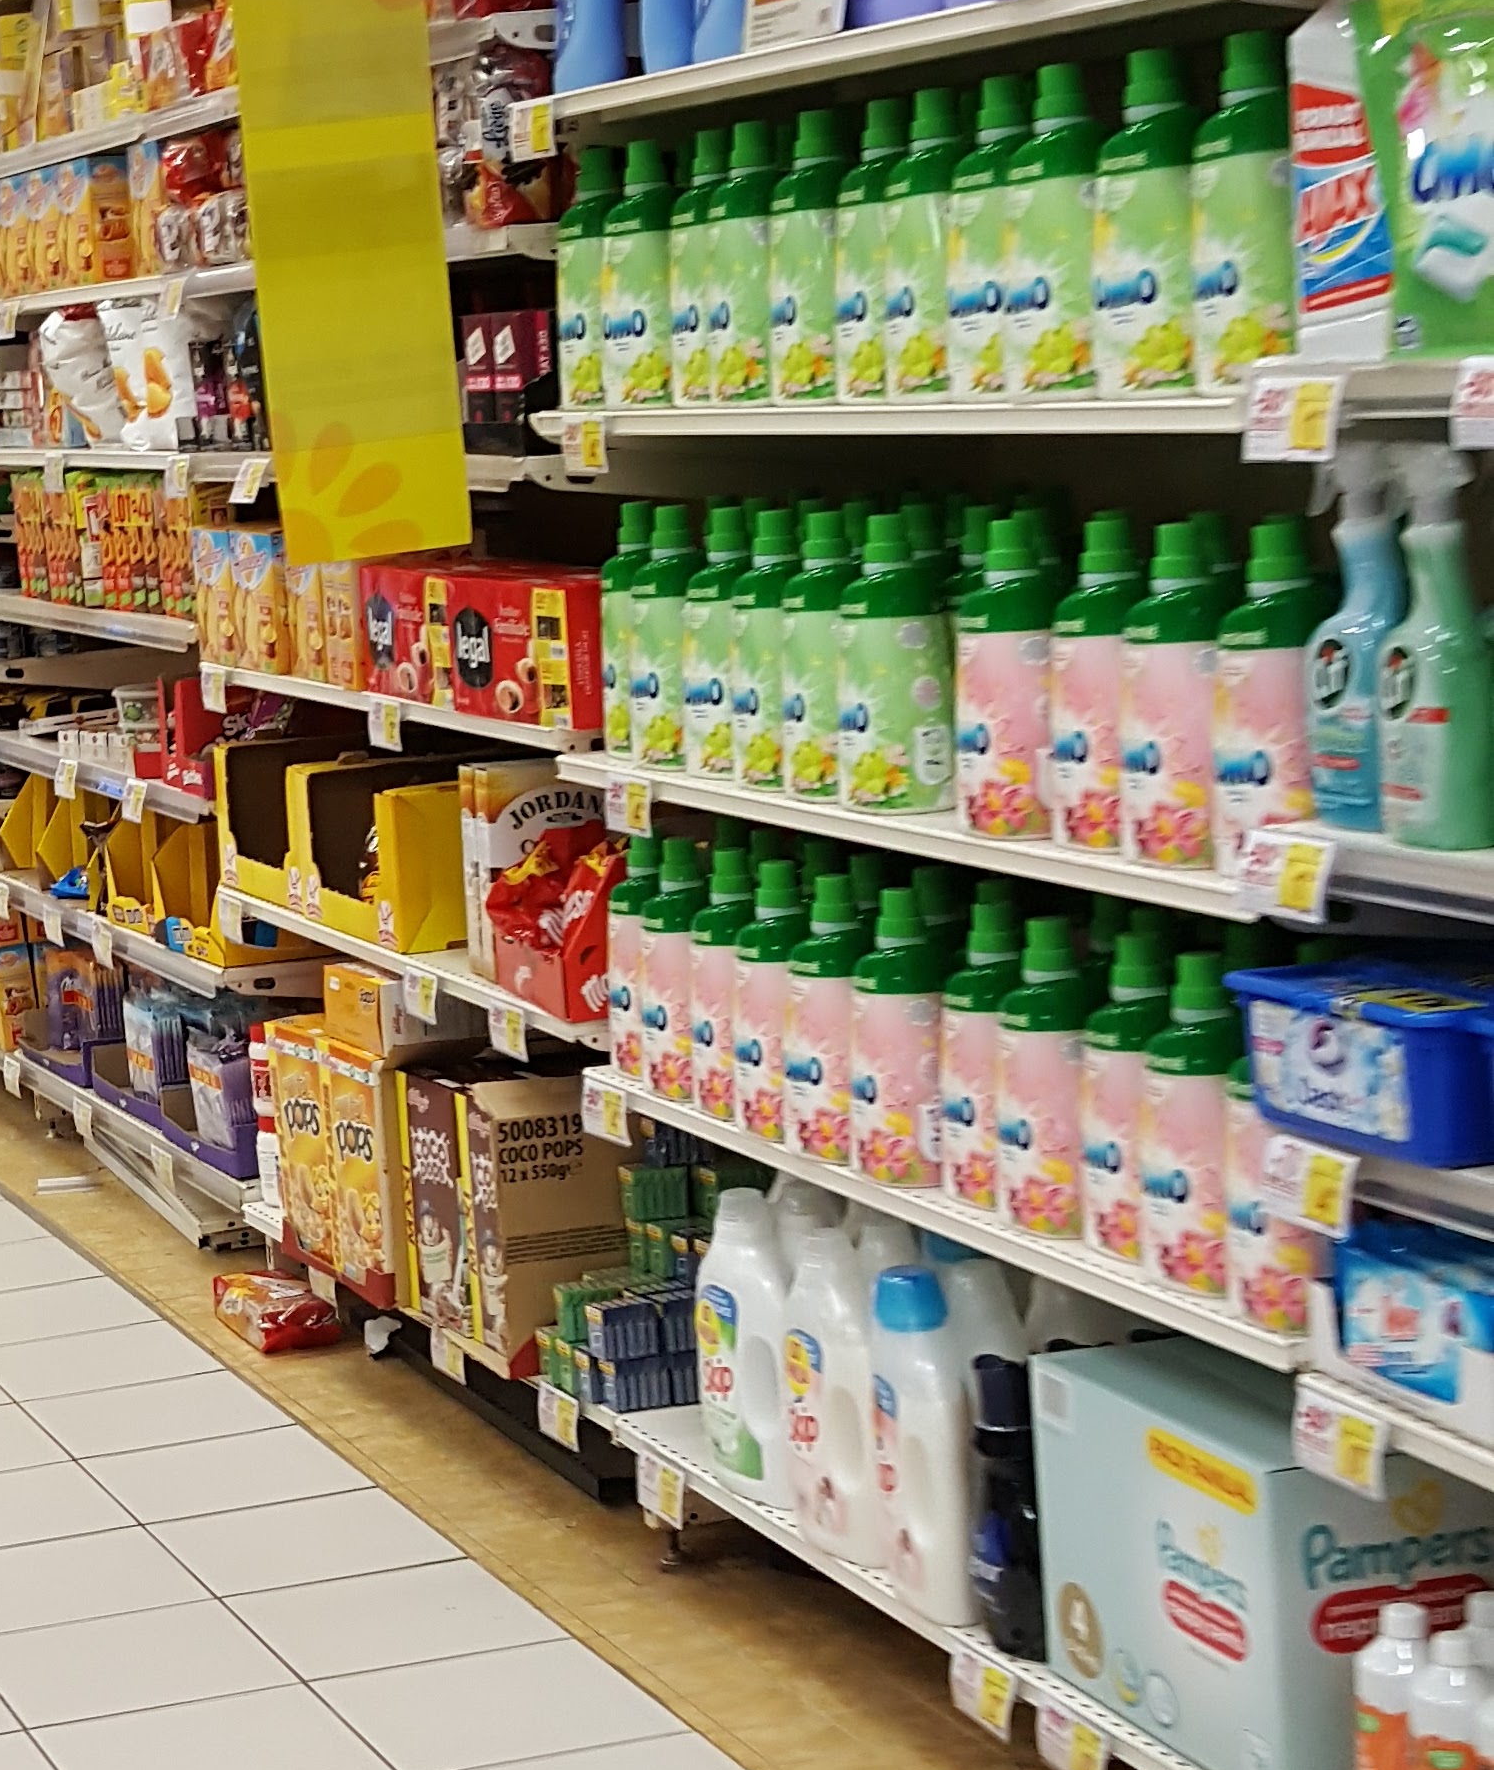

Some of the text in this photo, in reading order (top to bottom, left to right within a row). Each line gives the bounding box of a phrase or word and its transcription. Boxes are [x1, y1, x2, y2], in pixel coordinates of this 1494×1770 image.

[456, 621, 491, 668] legal
[509, 790, 604, 830] JORDAN
[334, 1122, 373, 1162] POPS
[498, 1113, 583, 1143] 5008319
[498, 1139, 583, 1166] COCO POPS
[500, 1167, 516, 1183] 12
[1302, 1524, 1494, 1590] Pampers
